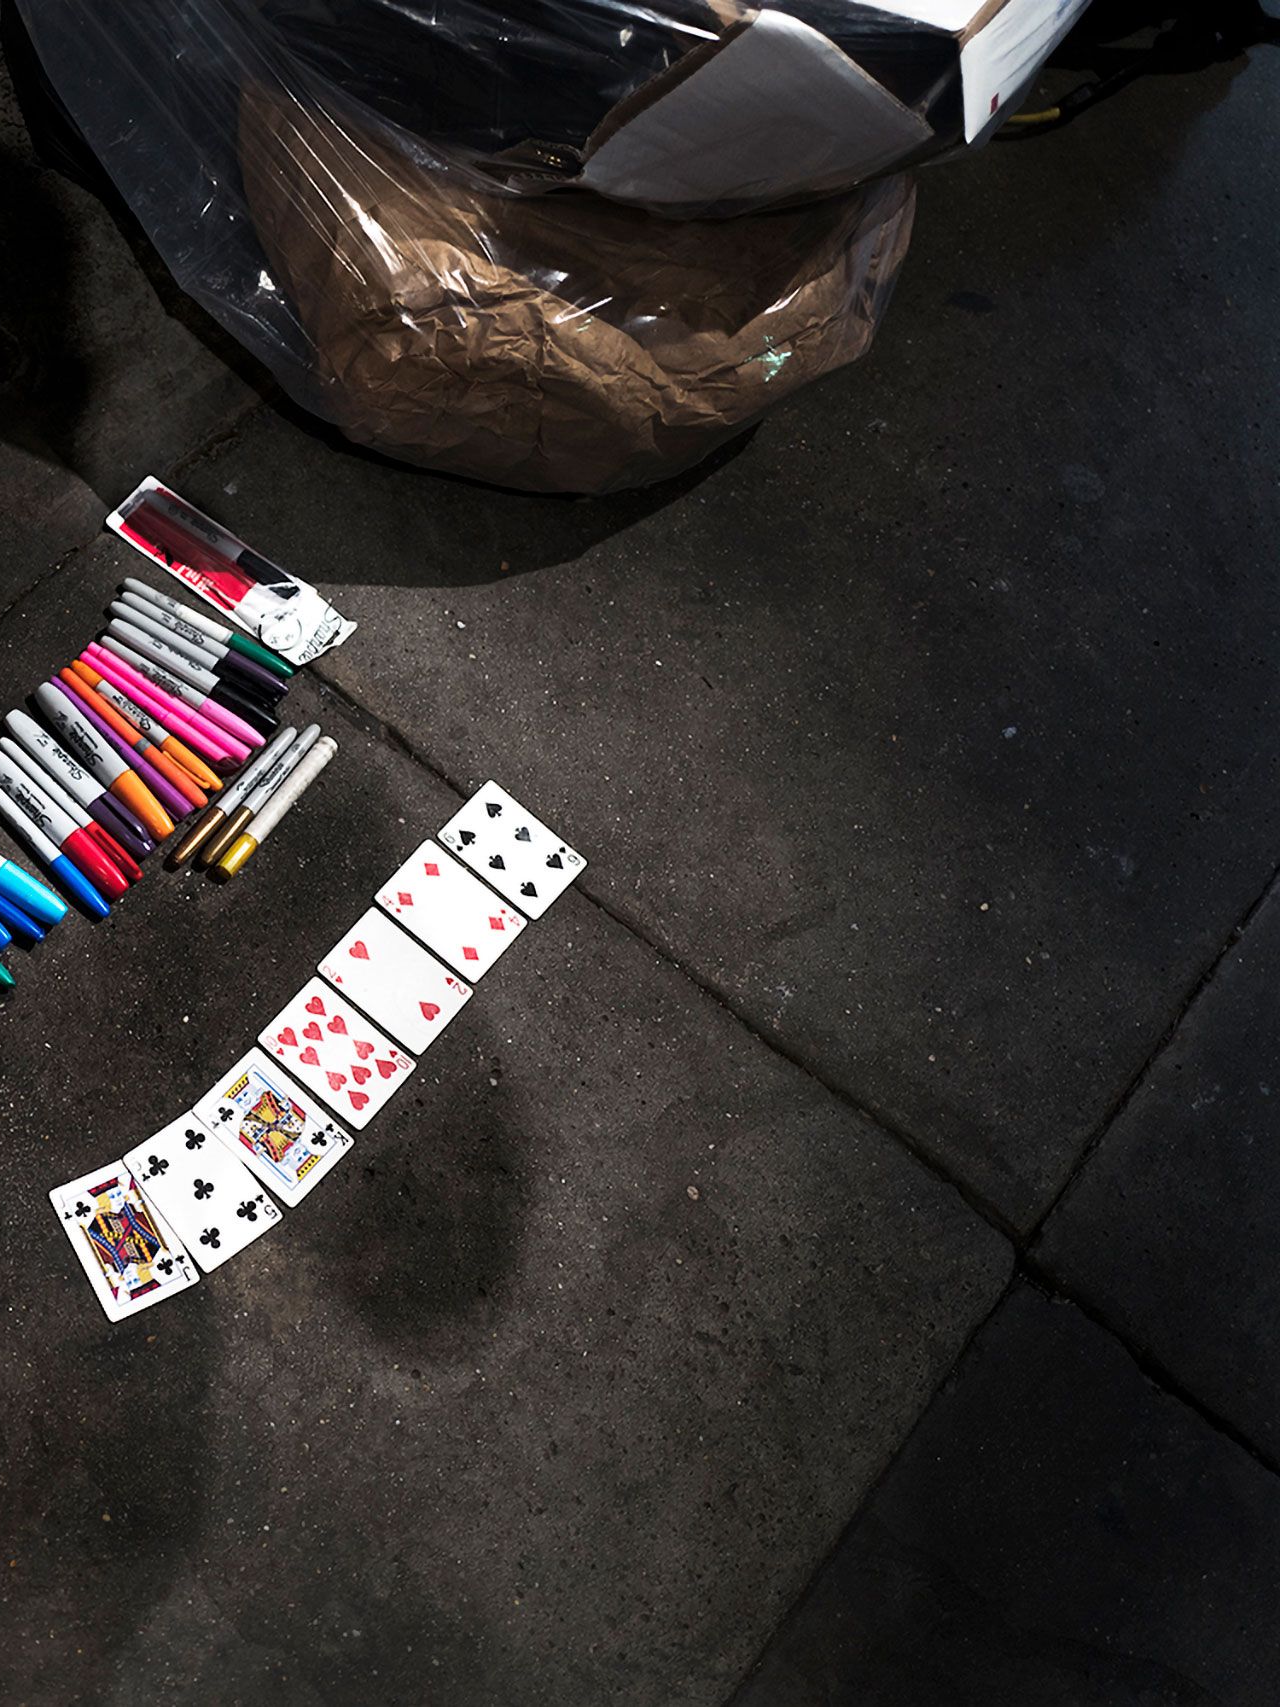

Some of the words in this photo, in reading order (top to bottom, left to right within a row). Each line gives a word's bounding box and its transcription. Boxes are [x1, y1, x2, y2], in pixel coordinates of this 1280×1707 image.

[442, 832, 456, 845] 6
[567, 854, 581, 866] 6
[322, 965, 336, 979] 2
[452, 981, 467, 996] 2
[395, 1054, 412, 1070] 10
[333, 1131, 350, 1147] K
[263, 1204, 278, 1220] 5
[182, 1266, 191, 1281] J
